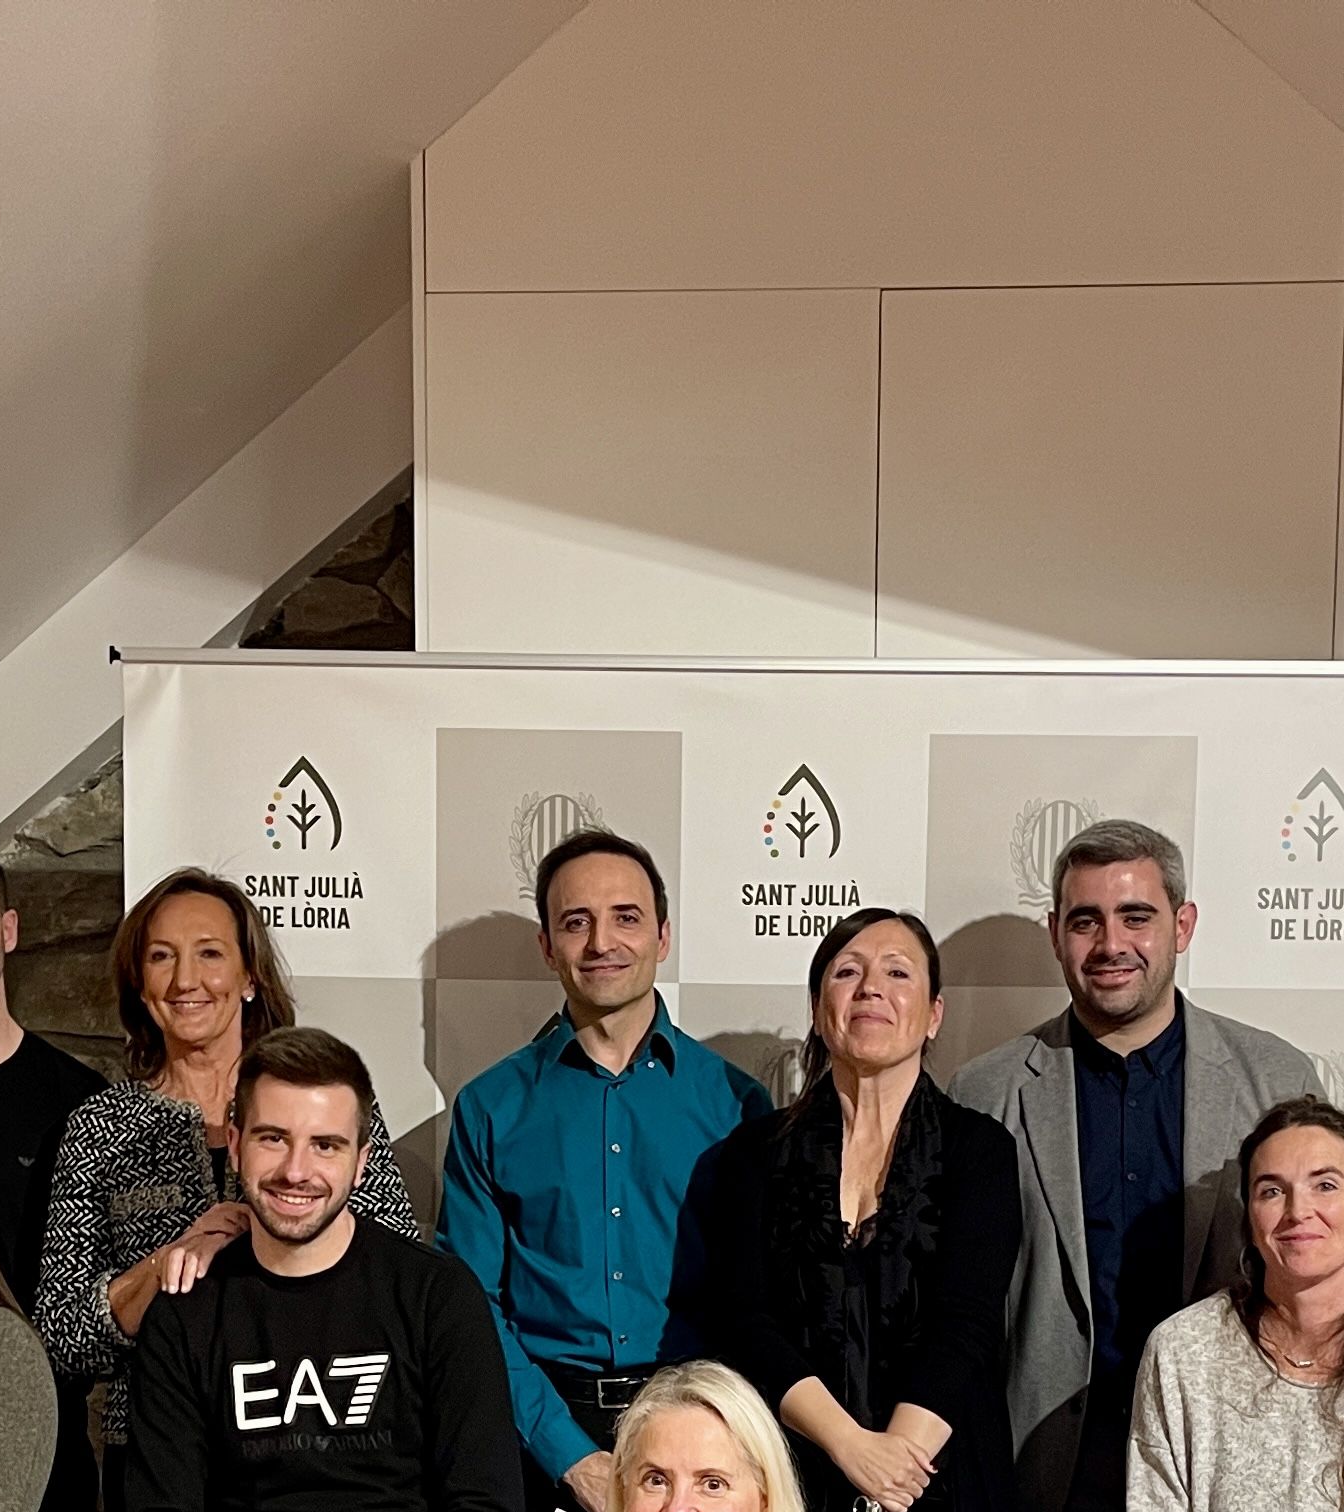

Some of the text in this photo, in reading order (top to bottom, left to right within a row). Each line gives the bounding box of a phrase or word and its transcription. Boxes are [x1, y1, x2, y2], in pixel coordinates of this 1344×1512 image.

[245, 871, 364, 899] SANT JULIÀ
[741, 879, 861, 907] SANT JULIÀ
[1257, 887, 1314, 910] SANT
[259, 901, 351, 929] DE LÒRIA
[755, 909, 843, 937] DE LÒRI
[1270, 918, 1297, 940] DE
[232, 1353, 391, 1431] EA7
